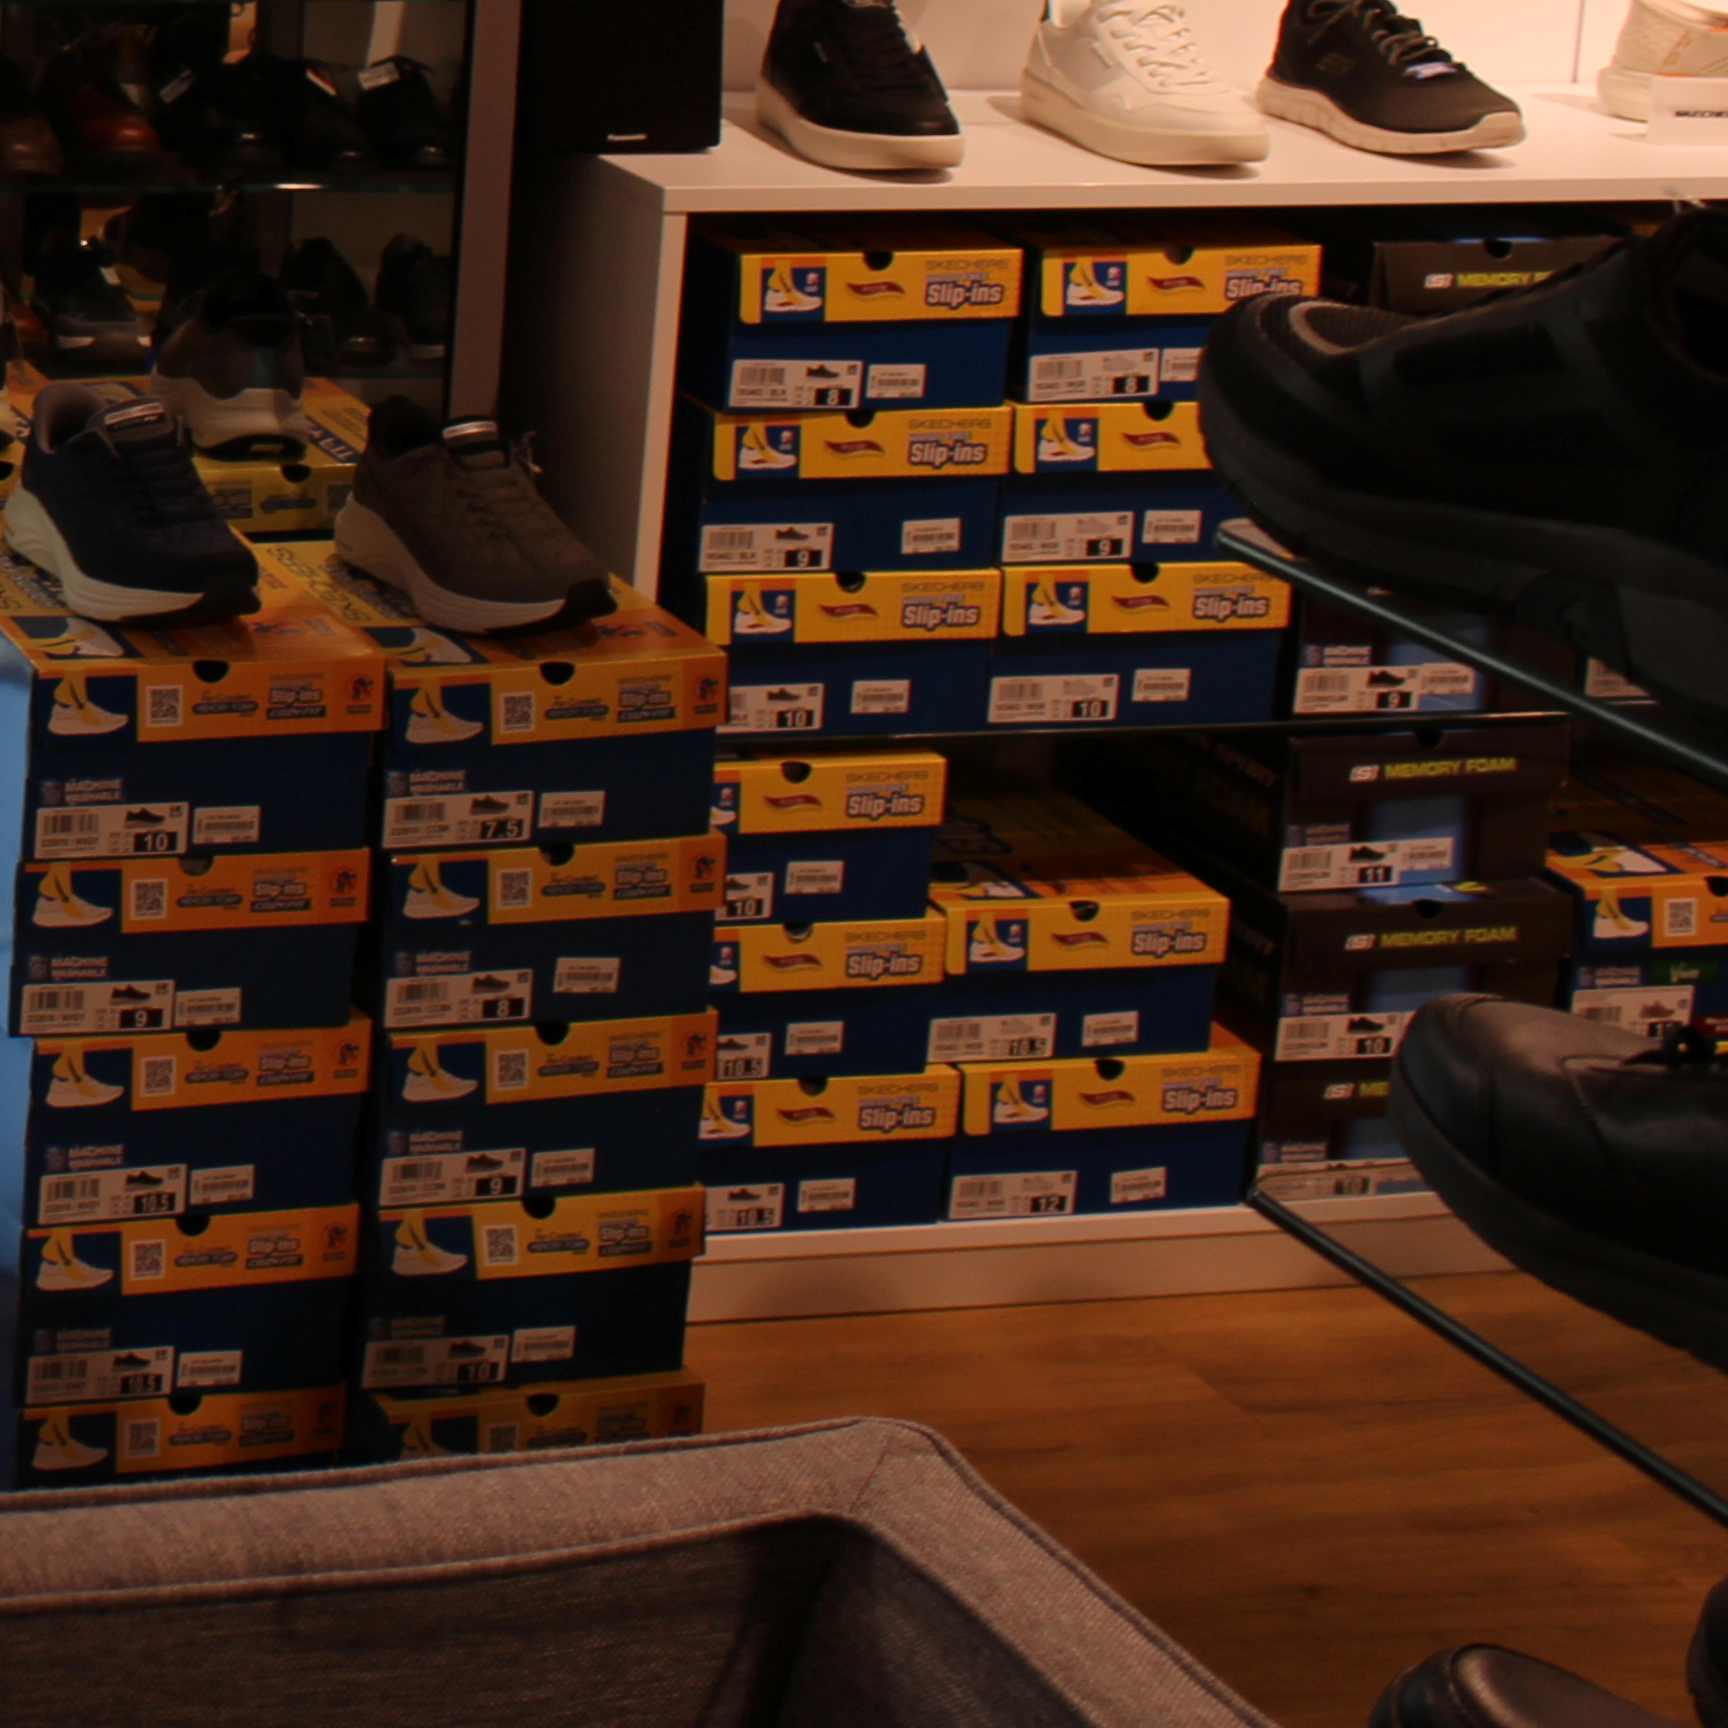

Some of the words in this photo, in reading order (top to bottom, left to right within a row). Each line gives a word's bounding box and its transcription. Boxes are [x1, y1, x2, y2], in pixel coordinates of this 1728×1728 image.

[924, 279, 1005, 310] Slip-ins
[1126, 377, 1139, 393] 8
[826, 390, 840, 405] 8
[908, 439, 989, 469] Slip-ins
[1098, 538, 1113, 556] 9
[796, 550, 811, 567] 9
[1193, 593, 1271, 623] Slip-ins
[902, 603, 980, 633] Slip-ins
[1079, 700, 1102, 718] 10
[1387, 692, 1401, 708] 9
[785, 710, 808, 728] 10
[1383, 759, 1461, 780] MEMORY
[1465, 756, 1518, 775] FOAM
[846, 793, 925, 821] Slip-ins
[485, 822, 521, 839] 7.5
[143, 833, 169, 852] 10
[1131, 930, 1208, 958] Slip-ins
[1379, 929, 1461, 949] MEMORY
[1466, 925, 1519, 944] FOAM
[846, 951, 922, 980] Slip-ins
[133, 1009, 148, 1027] 9
[496, 1000, 511, 1018] 8
[1361, 1038, 1385, 1054] 10
[1161, 1085, 1238, 1115] Slip-ins
[858, 1104, 935, 1133] Slip-ins
[489, 1178, 504, 1196] 9
[1038, 1195, 1062, 1212] 12
